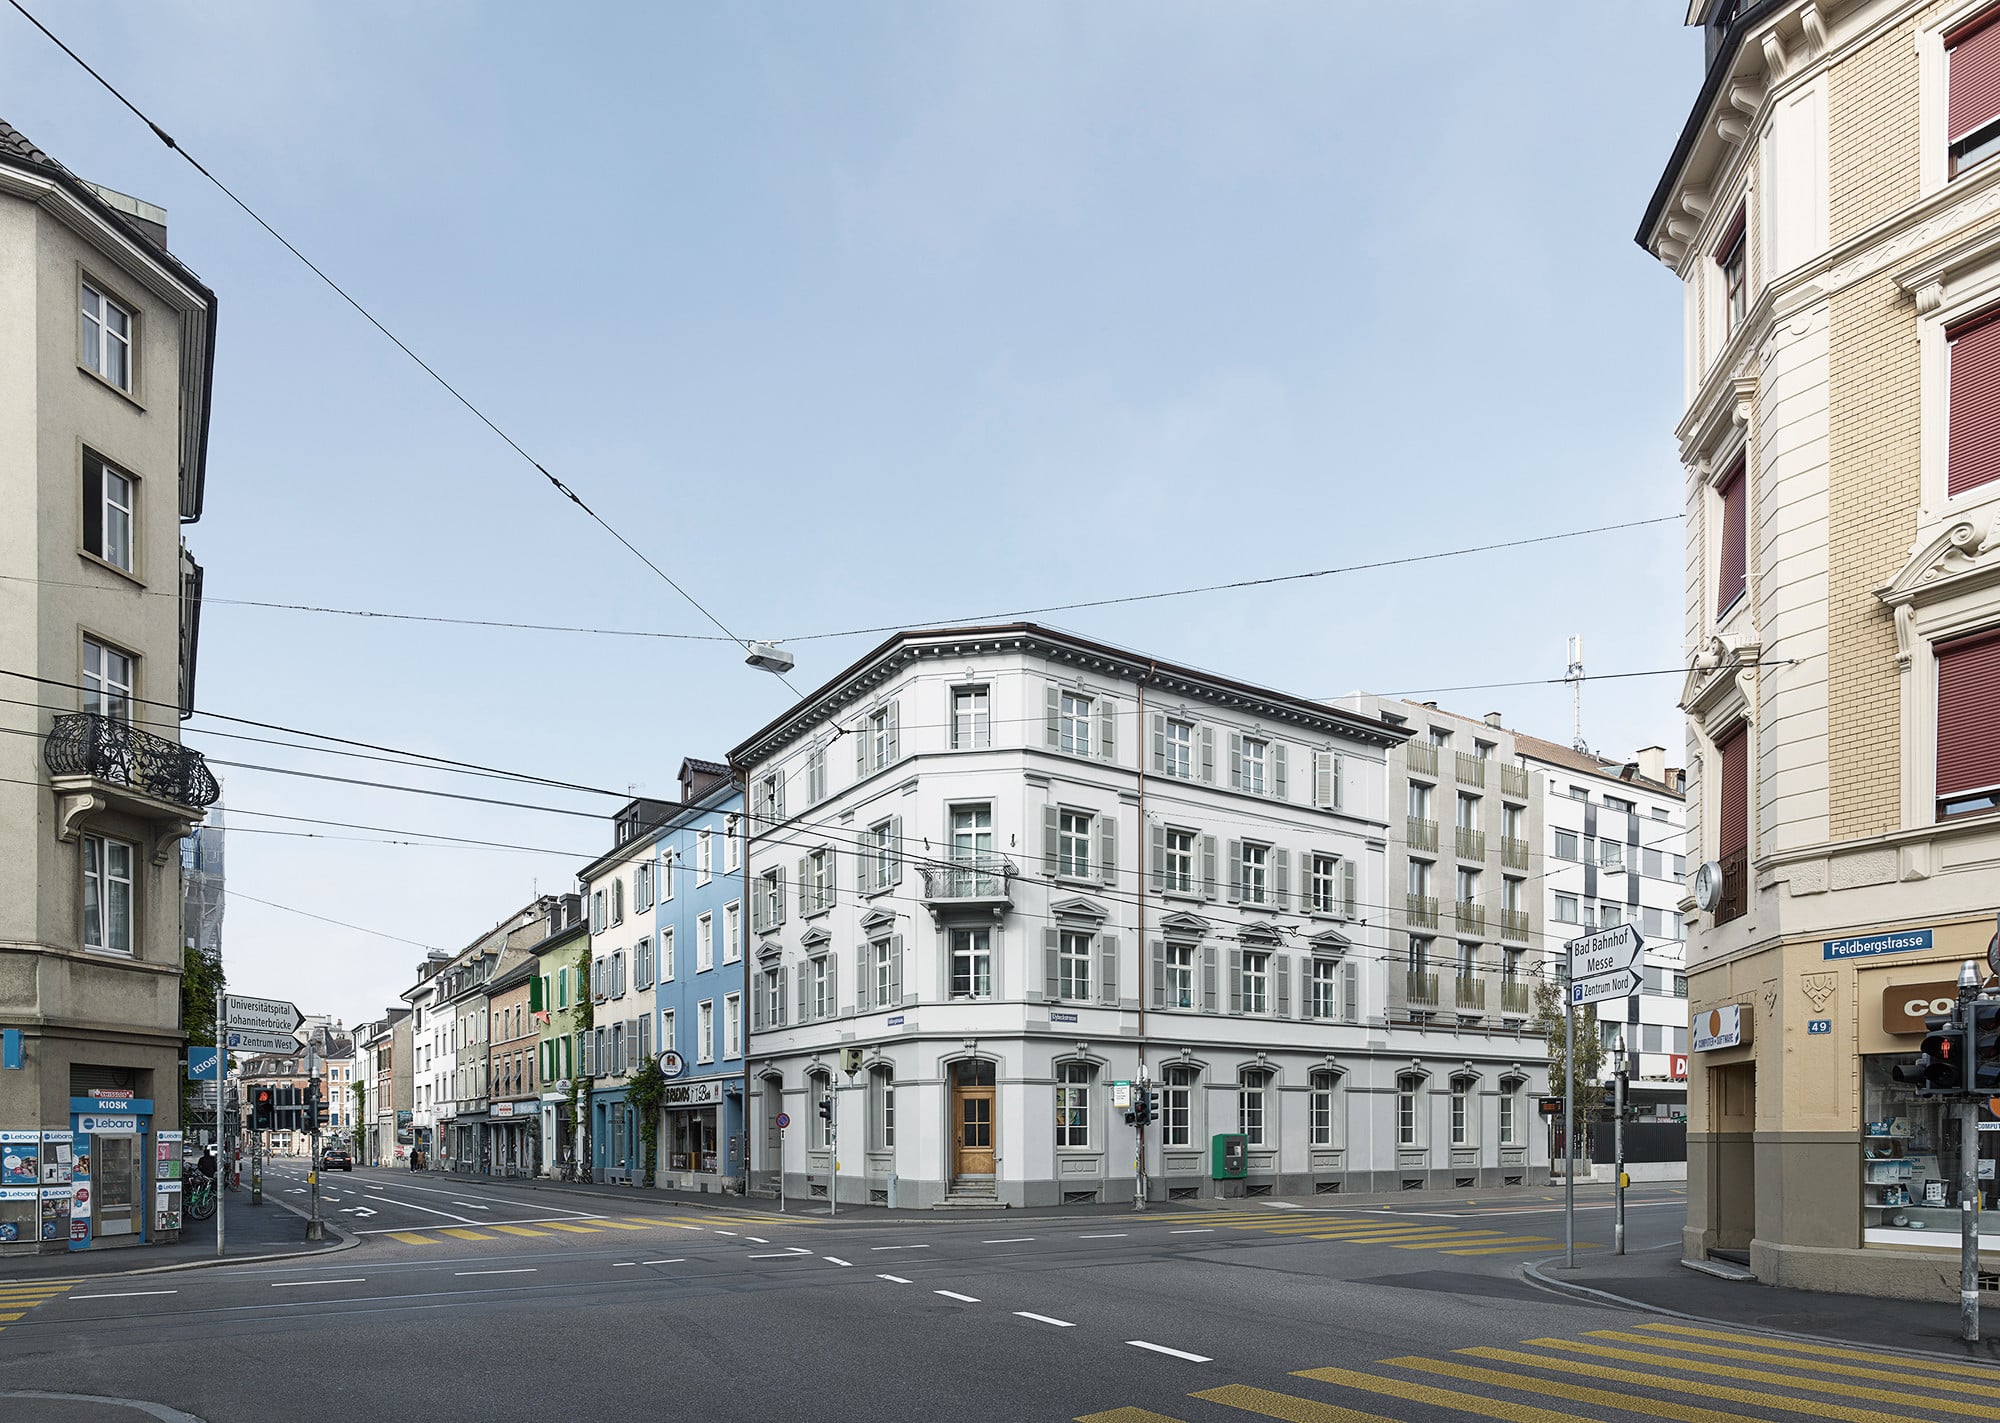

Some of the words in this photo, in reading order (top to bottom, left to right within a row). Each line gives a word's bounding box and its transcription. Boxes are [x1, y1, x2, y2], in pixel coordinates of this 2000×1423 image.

[1574, 939, 1590, 957] Bad
[1592, 927, 1629, 952] Bahnhof
[1831, 936, 1923, 956] Feldbergstrasse
[1587, 956, 1614, 973] Messe
[1584, 981, 1611, 997] Zentrum
[1612, 975, 1629, 991] Nord
[230, 998, 291, 1016] Universitätspital
[229, 1014, 292, 1030] Johanniterbrücke
[1811, 1022, 1828, 1032] 49
[242, 1035, 274, 1047] Zentrum
[274, 1038, 293, 1050] West
[98, 1100, 128, 1110] KIOSK
[95, 1117, 134, 1129] Lebara
[8, 1190, 37, 1198] Lebara
[48, 1189, 71, 1197] Lebara
